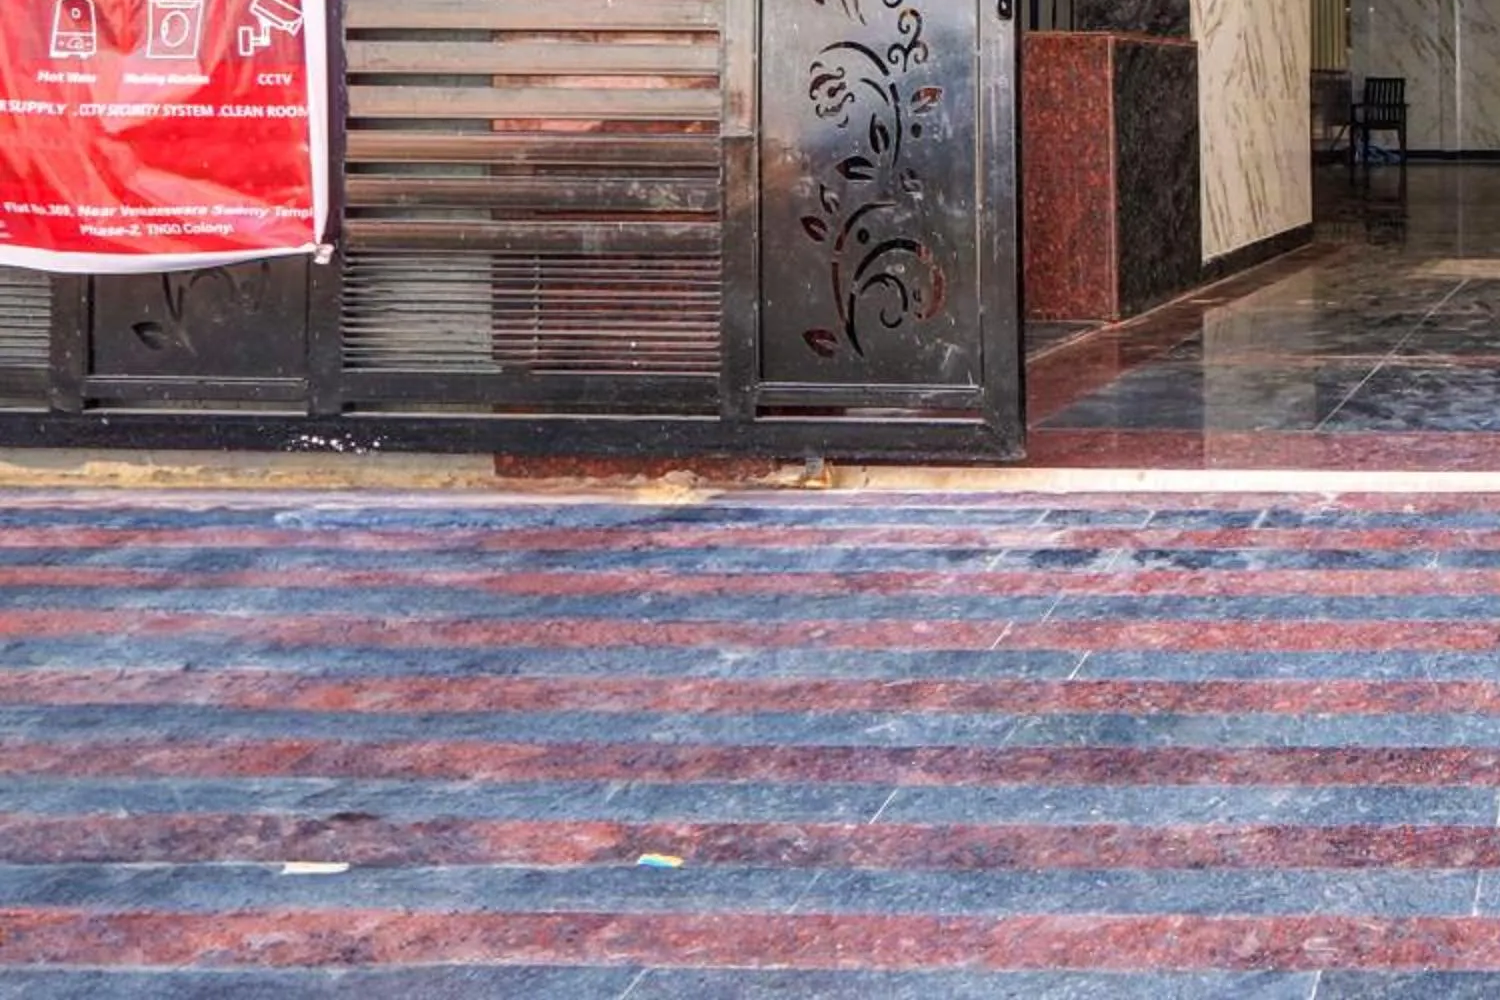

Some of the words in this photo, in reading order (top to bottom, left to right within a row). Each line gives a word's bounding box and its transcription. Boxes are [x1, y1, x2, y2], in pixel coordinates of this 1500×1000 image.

[257, 73, 293, 86] CCTV
[8, 99, 66, 116] SUPPLY
[162, 104, 214, 117] SYSTEM
